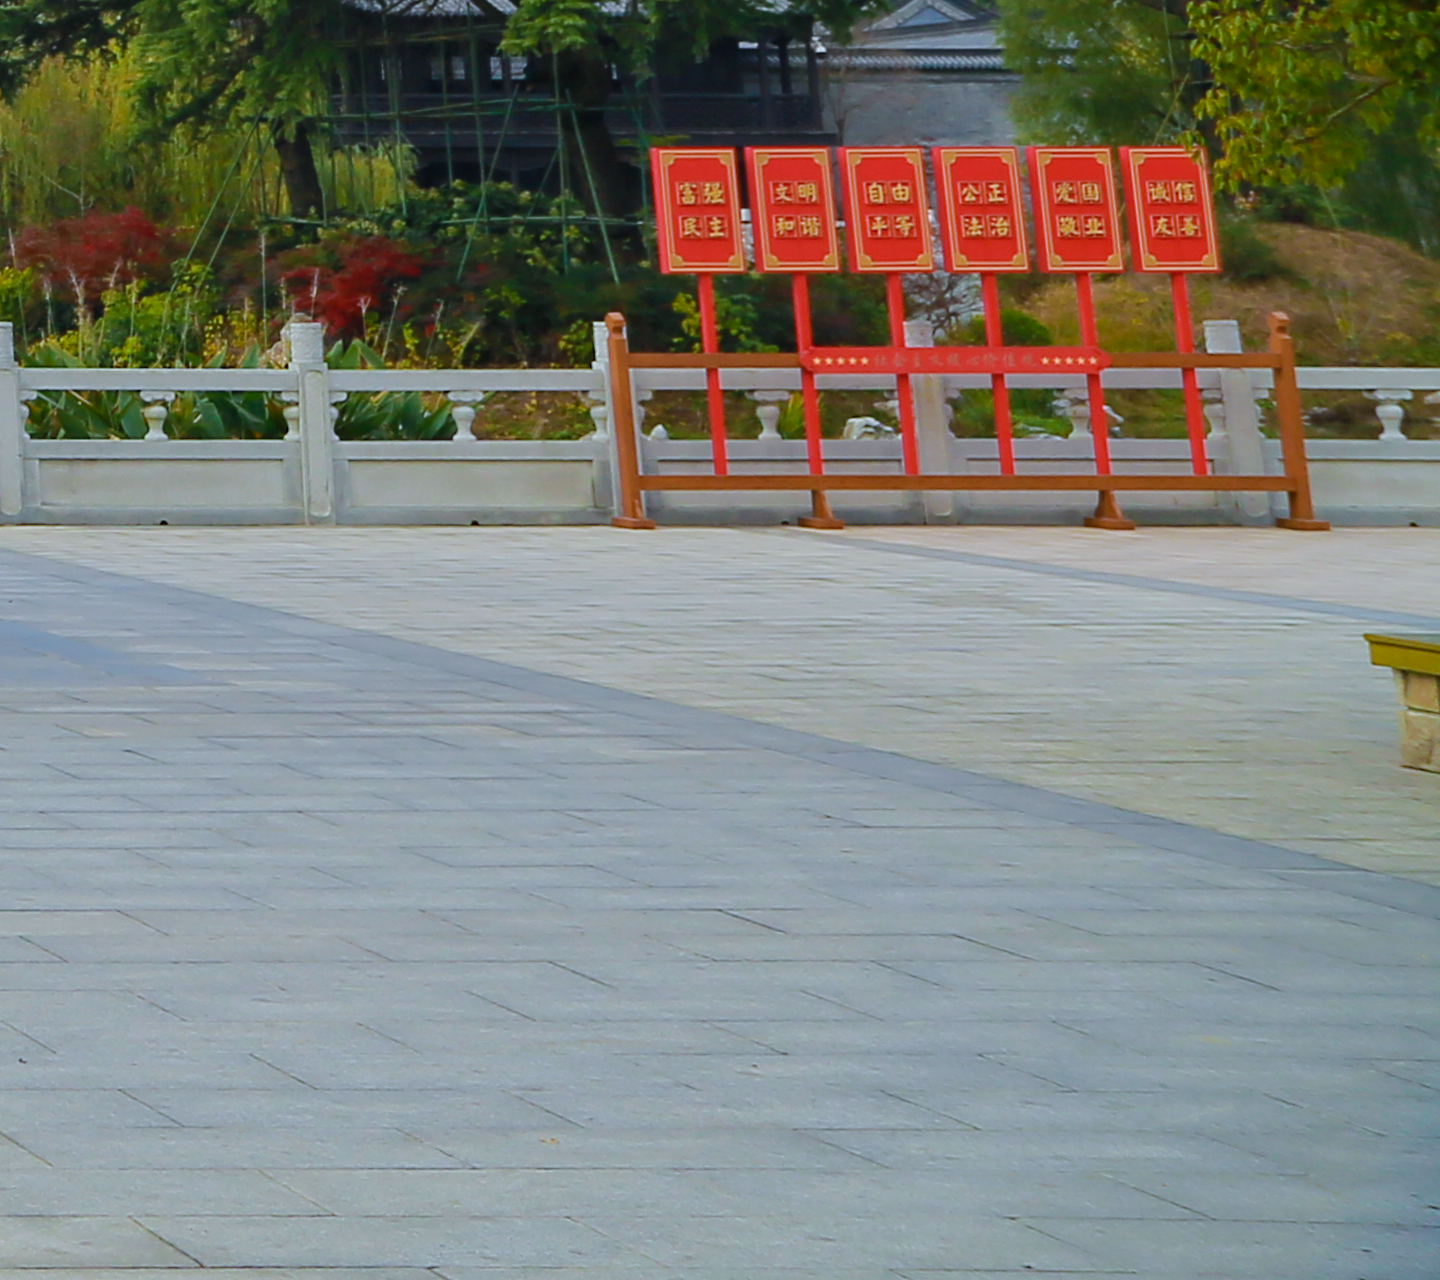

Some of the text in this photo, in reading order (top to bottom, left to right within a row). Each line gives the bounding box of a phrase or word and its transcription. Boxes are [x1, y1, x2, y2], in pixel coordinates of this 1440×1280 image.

[679, 182, 725, 204] 富强
[775, 183, 817, 203] 文明
[867, 183, 912, 204] 自由
[961, 183, 1006, 203] 公正
[1056, 183, 1101, 203] 爱国
[1148, 182, 1196, 203] 诚信
[682, 217, 726, 237] 民主
[775, 216, 821, 237] 和谐
[870, 216, 915, 237] 平等
[964, 216, 1010, 237] 法治
[1058, 216, 1105, 237] 敬业
[1153, 216, 1199, 237] 友善
